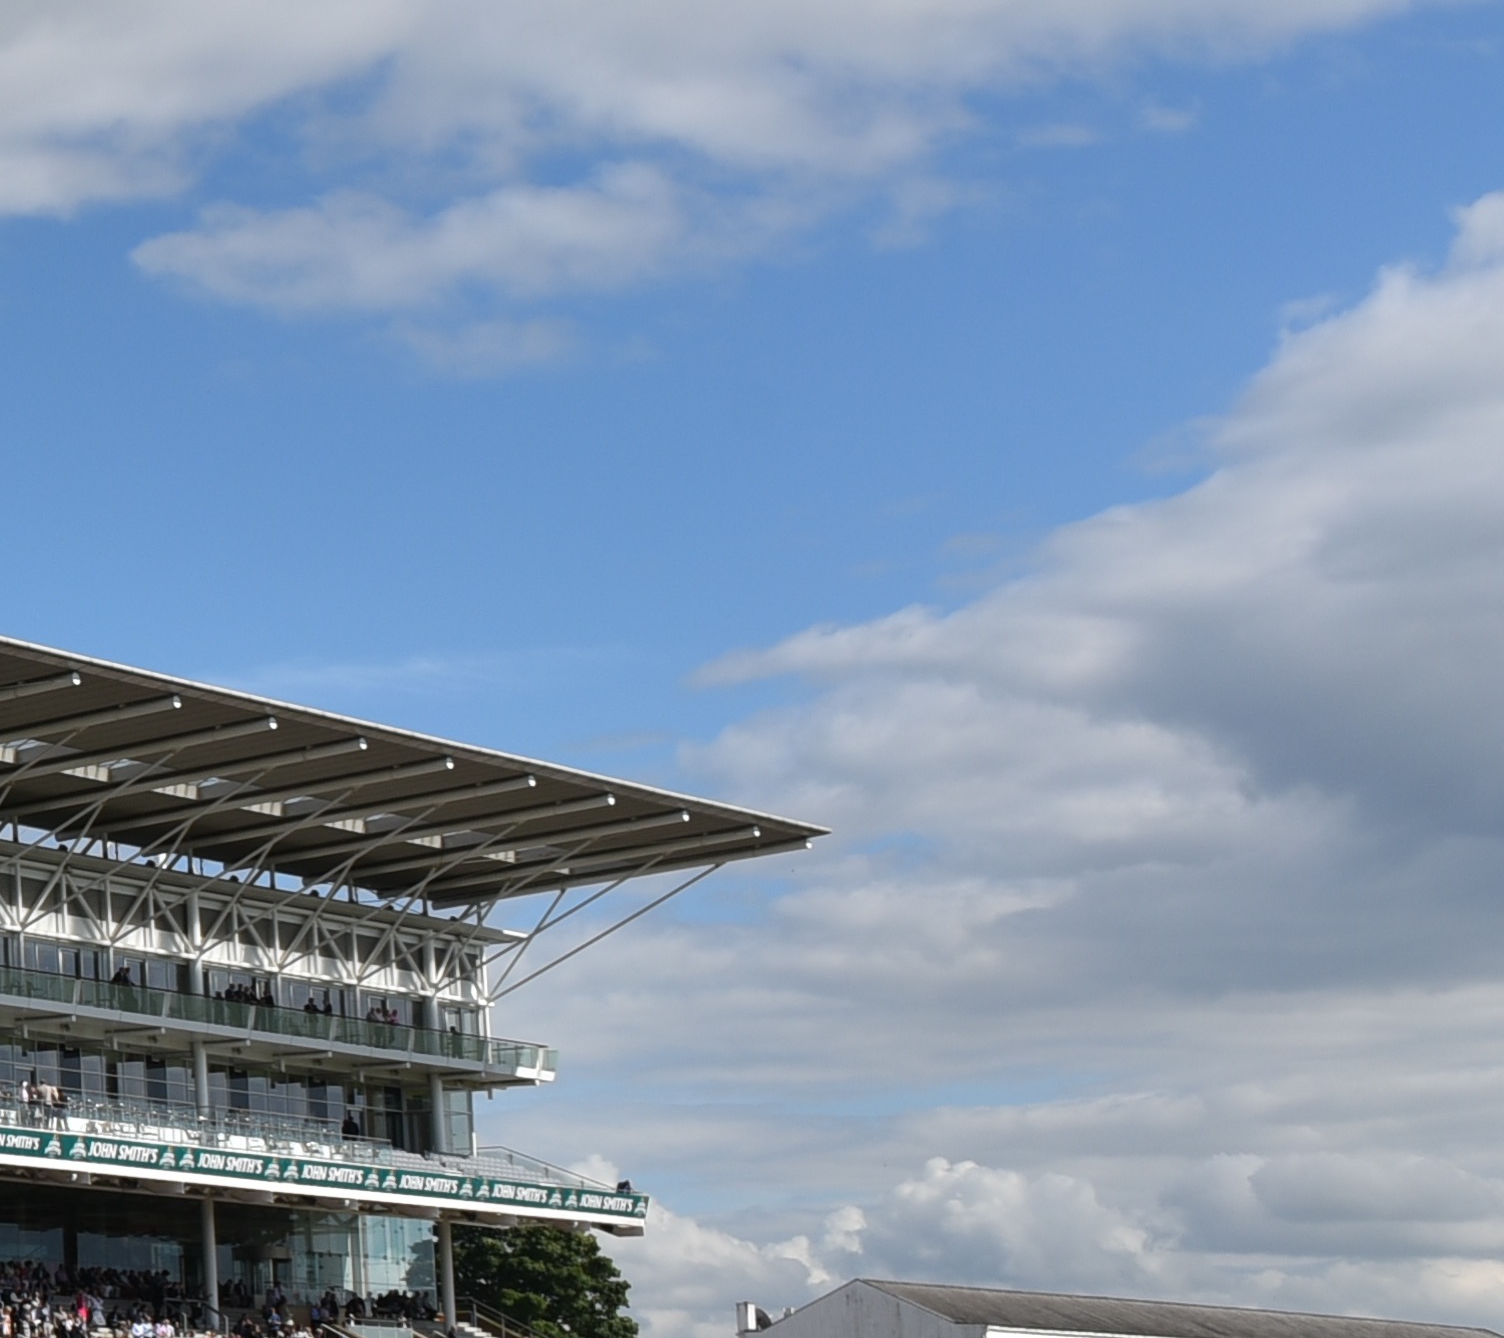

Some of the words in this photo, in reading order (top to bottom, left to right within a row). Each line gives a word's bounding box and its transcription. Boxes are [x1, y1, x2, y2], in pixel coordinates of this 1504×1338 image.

[6, 1134, 40, 1150] SMITH'S
[88, 1141, 118, 1159] JOHN
[118, 1144, 159, 1163] SMITH'S
[197, 1152, 226, 1170] JOHN
[225, 1156, 263, 1174] SMITH'S
[301, 1164, 329, 1180] JOHN
[328, 1167, 363, 1184] SMITH'S
[399, 1174, 425, 1190] JOHN
[424, 1177, 458, 1194] SMITH'S
[492, 1183, 517, 1199] JOHN
[517, 1186, 548, 1203] SMITH'S
[580, 1193, 605, 1210] JOHN
[604, 1196, 633, 1213] SMITH'S
